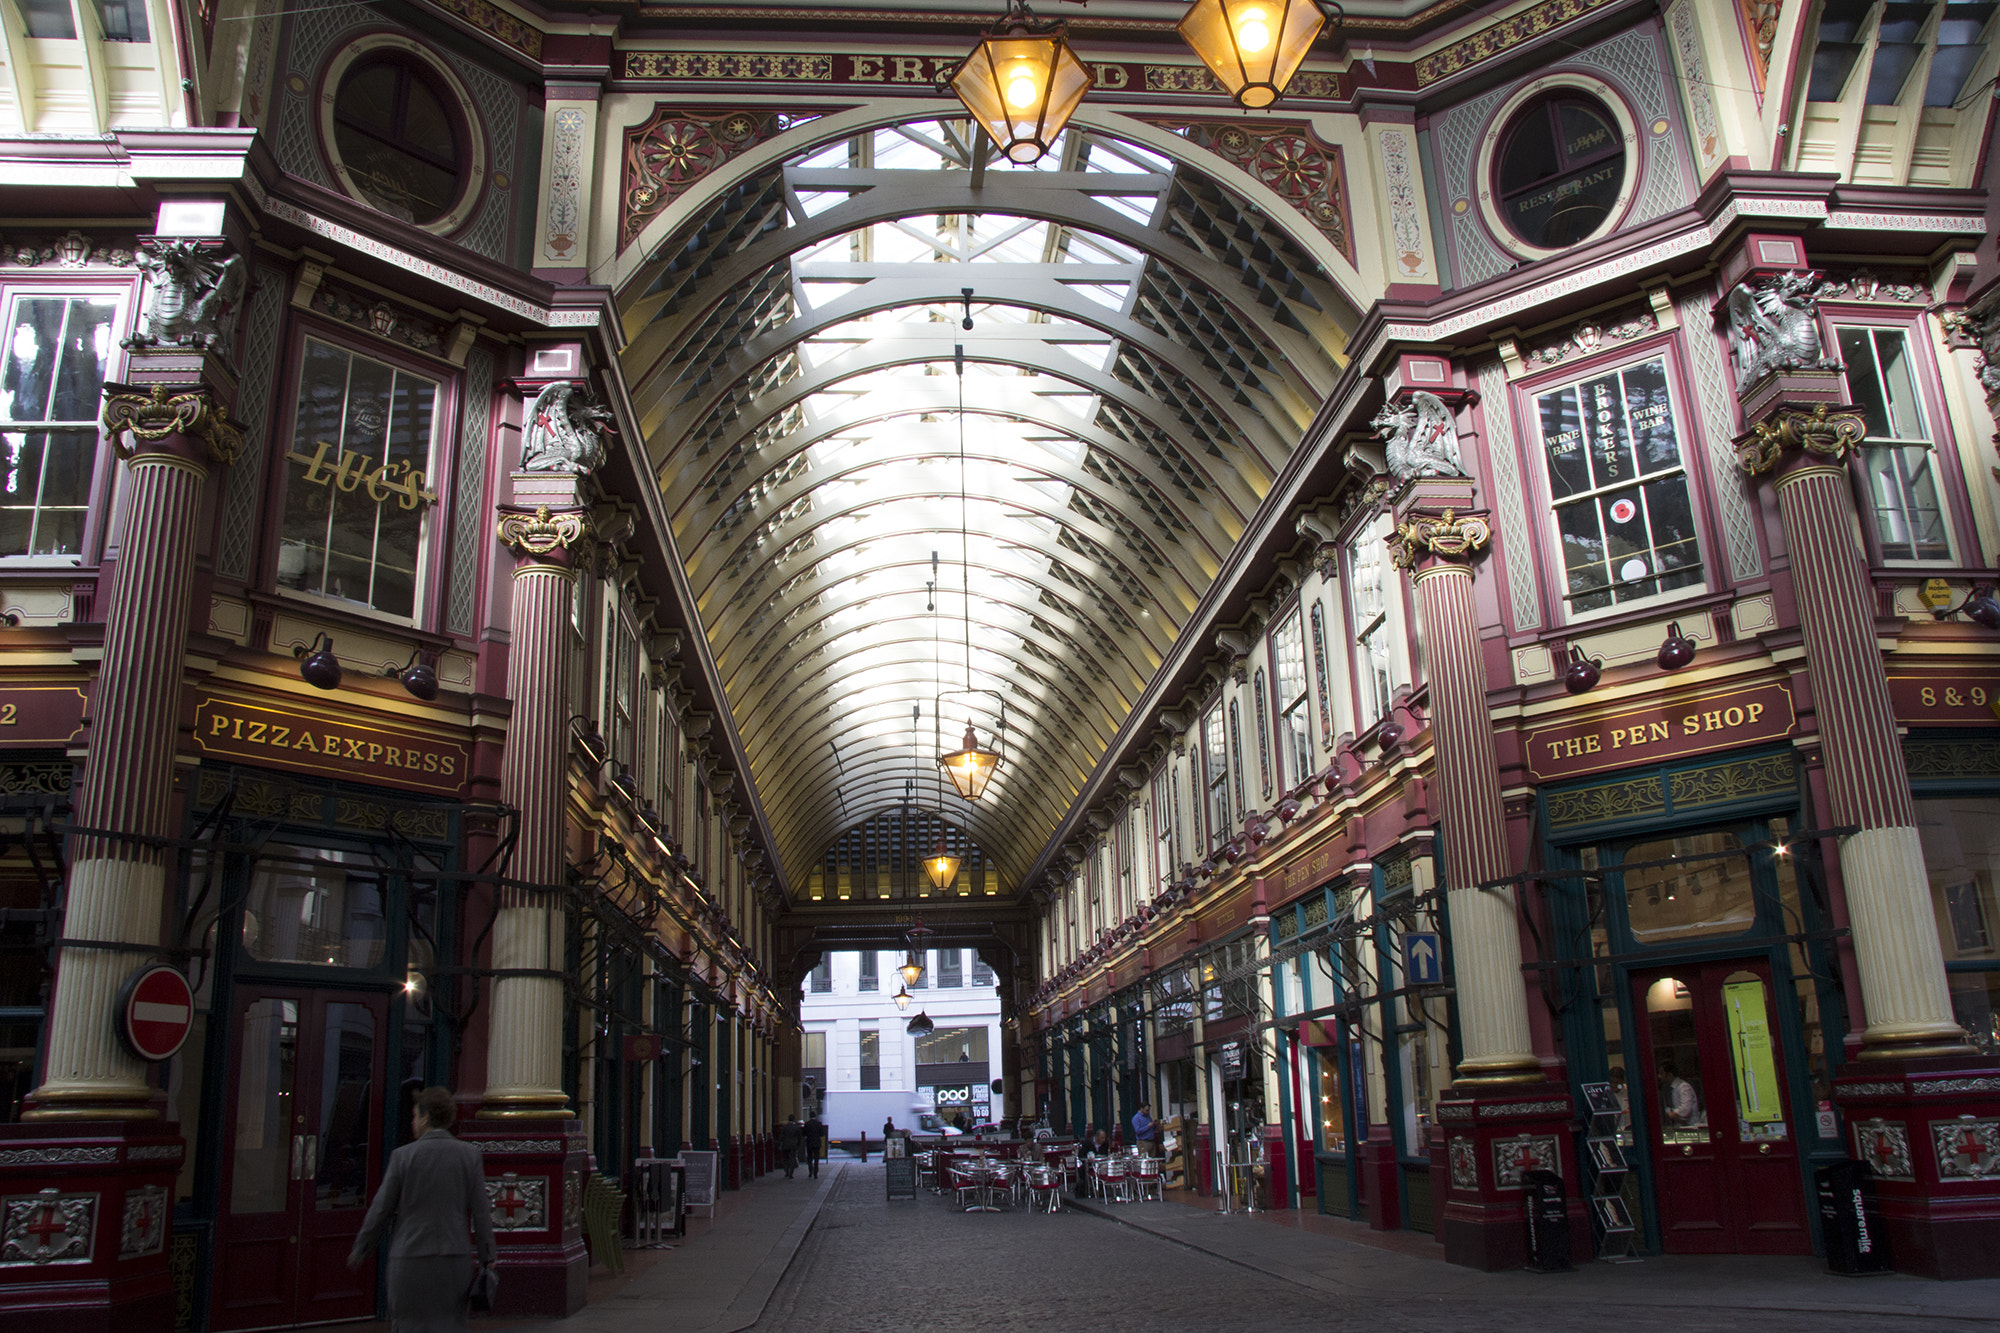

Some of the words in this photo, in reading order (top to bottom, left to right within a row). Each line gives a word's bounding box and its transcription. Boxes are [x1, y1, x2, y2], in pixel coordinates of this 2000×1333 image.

[1518, 167, 1614, 212] RESTAURANT
[1633, 403, 1668, 424] WINE
[1639, 415, 1665, 431] BAR
[1547, 429, 1580, 447] WINE
[1594, 383, 1620, 478] BROKERS
[1553, 442, 1577, 457] BAR
[1921, 687, 1937, 707] 8
[1945, 687, 1965, 707] &
[1970, 687, 1987, 707] 9
[0, 704, 17, 725] 2
[1547, 734, 1602, 760] THE
[1611, 721, 1670, 749] PEN
[1682, 703, 1764, 736] SHOP
[209, 714, 457, 776] PIZZAEXPRESS
[1284, 872, 1297, 890] THE
[1297, 864, 1310, 884] PEN
[1312, 853, 1329, 874] SHOP
[938, 1085, 968, 1104] pod
